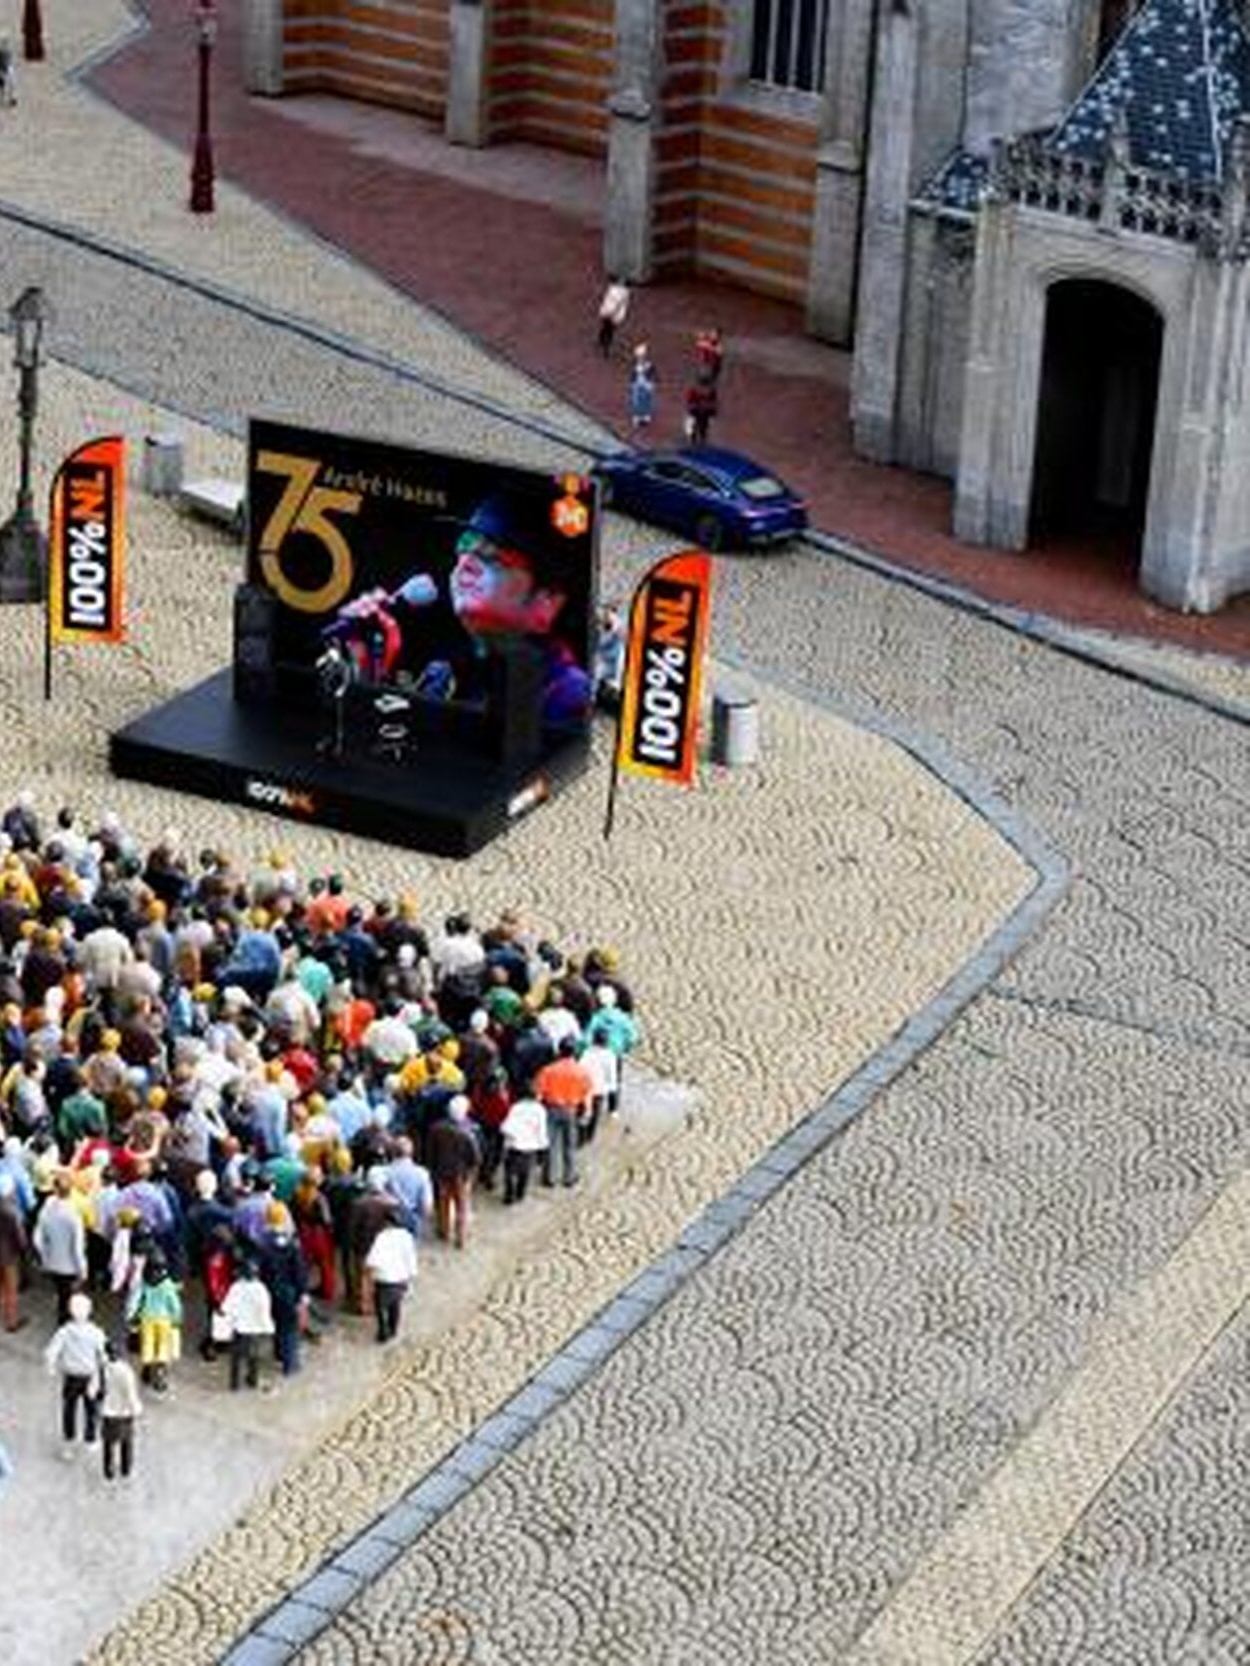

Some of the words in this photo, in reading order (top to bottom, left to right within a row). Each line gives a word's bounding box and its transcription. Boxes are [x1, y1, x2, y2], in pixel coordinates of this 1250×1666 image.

[68, 470, 107, 625] 100%NL
[256, 450, 363, 614] 75
[638, 590, 693, 762] 100%NL
